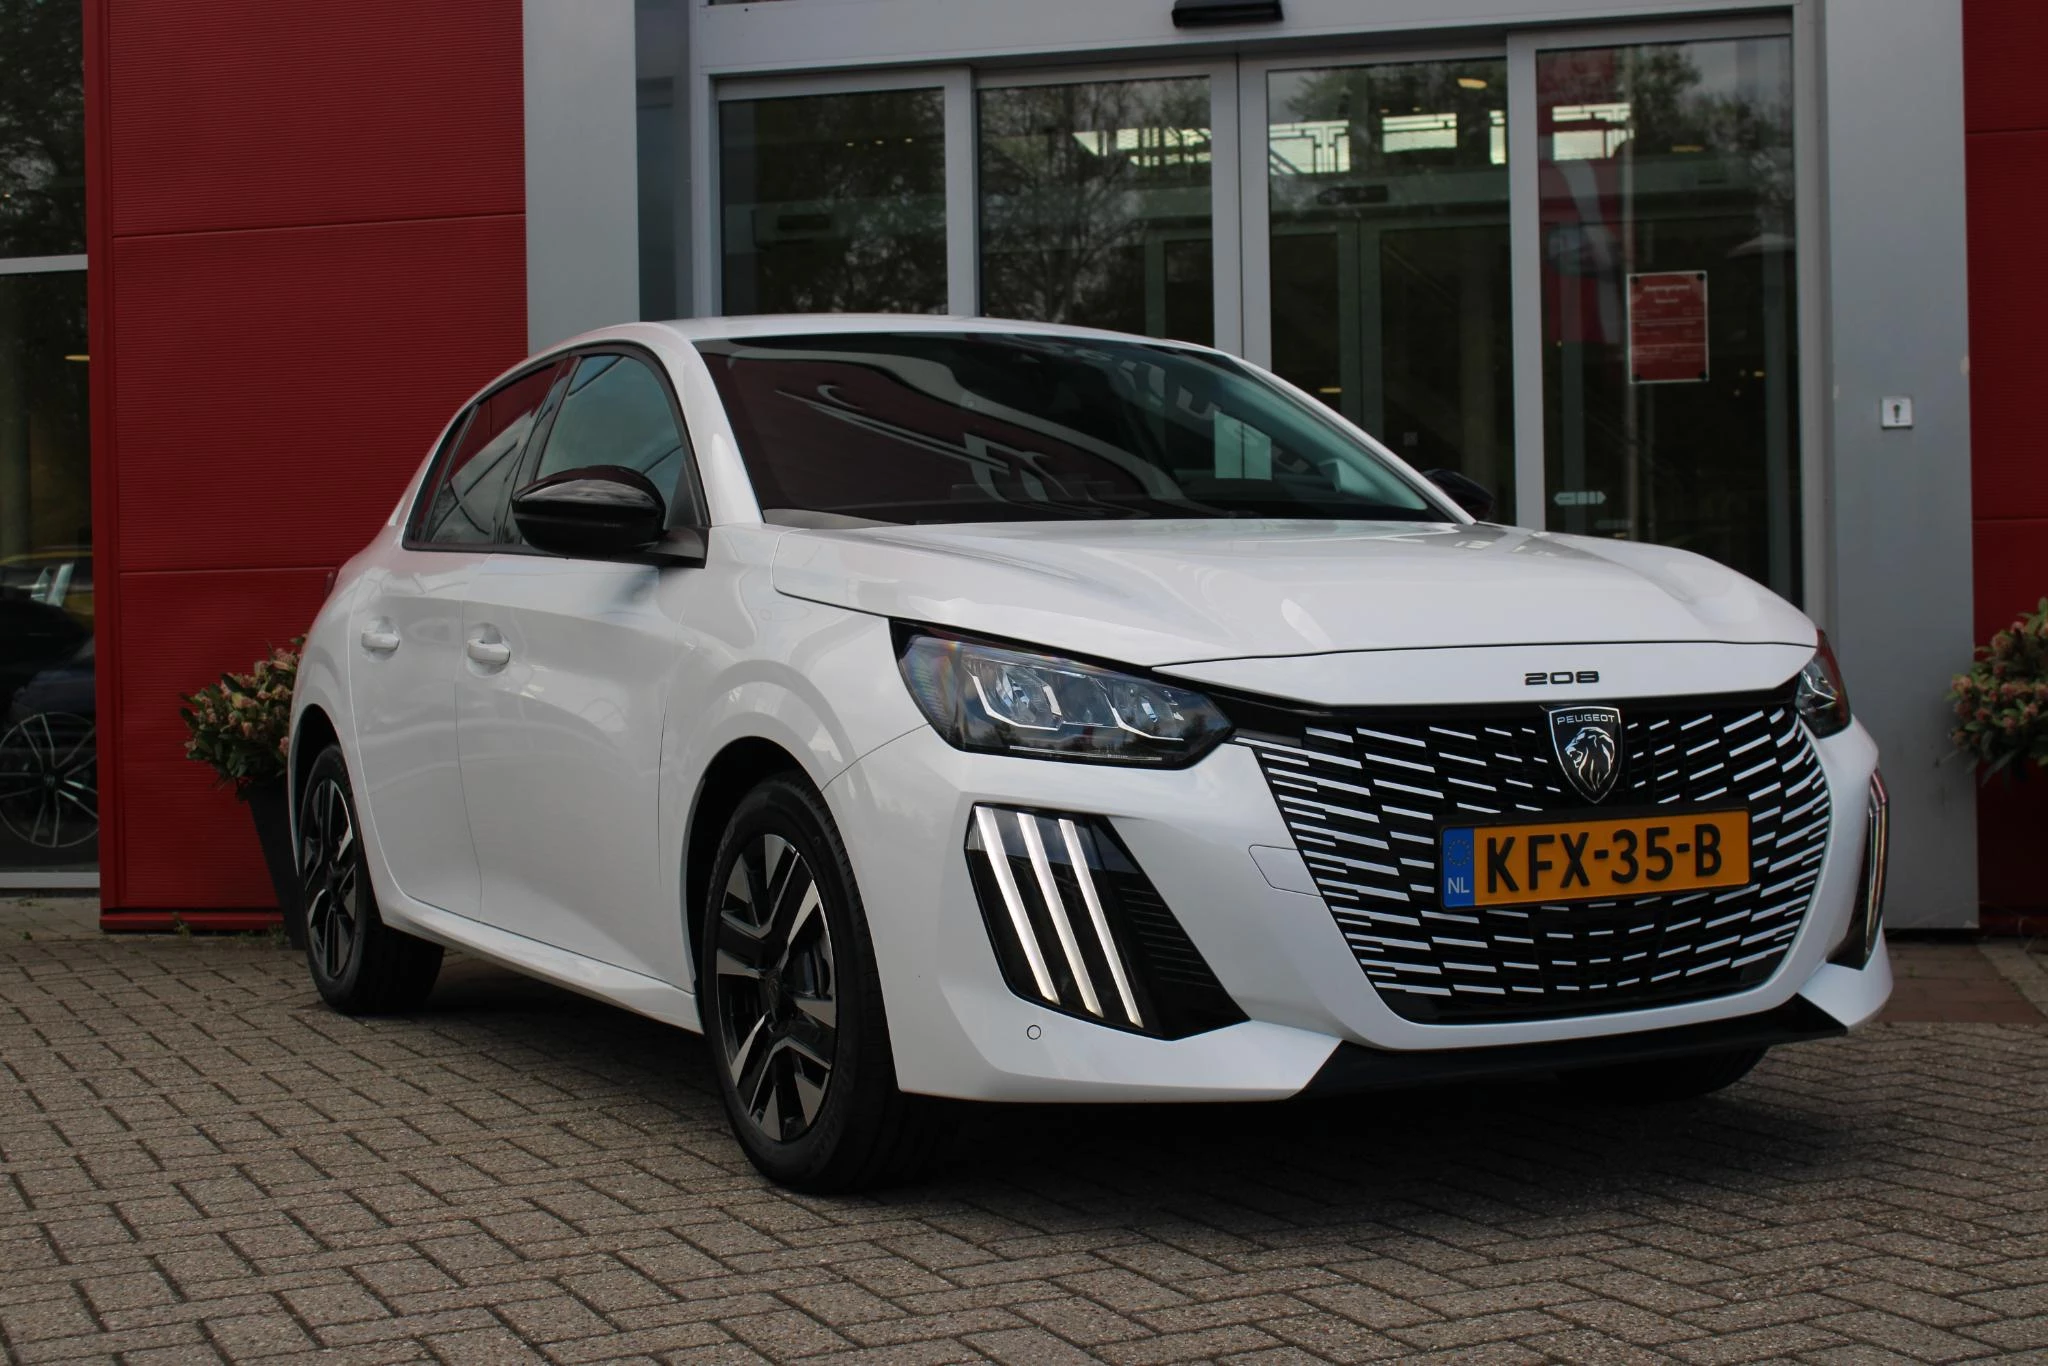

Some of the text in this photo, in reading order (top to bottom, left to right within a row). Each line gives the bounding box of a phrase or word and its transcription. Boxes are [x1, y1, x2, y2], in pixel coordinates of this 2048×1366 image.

[1525, 671, 1600, 686] 208
[1556, 713, 1615, 725] PEUGEOT
[1486, 823, 1722, 893] KFX-35-B
[1447, 876, 1470, 895] NL
